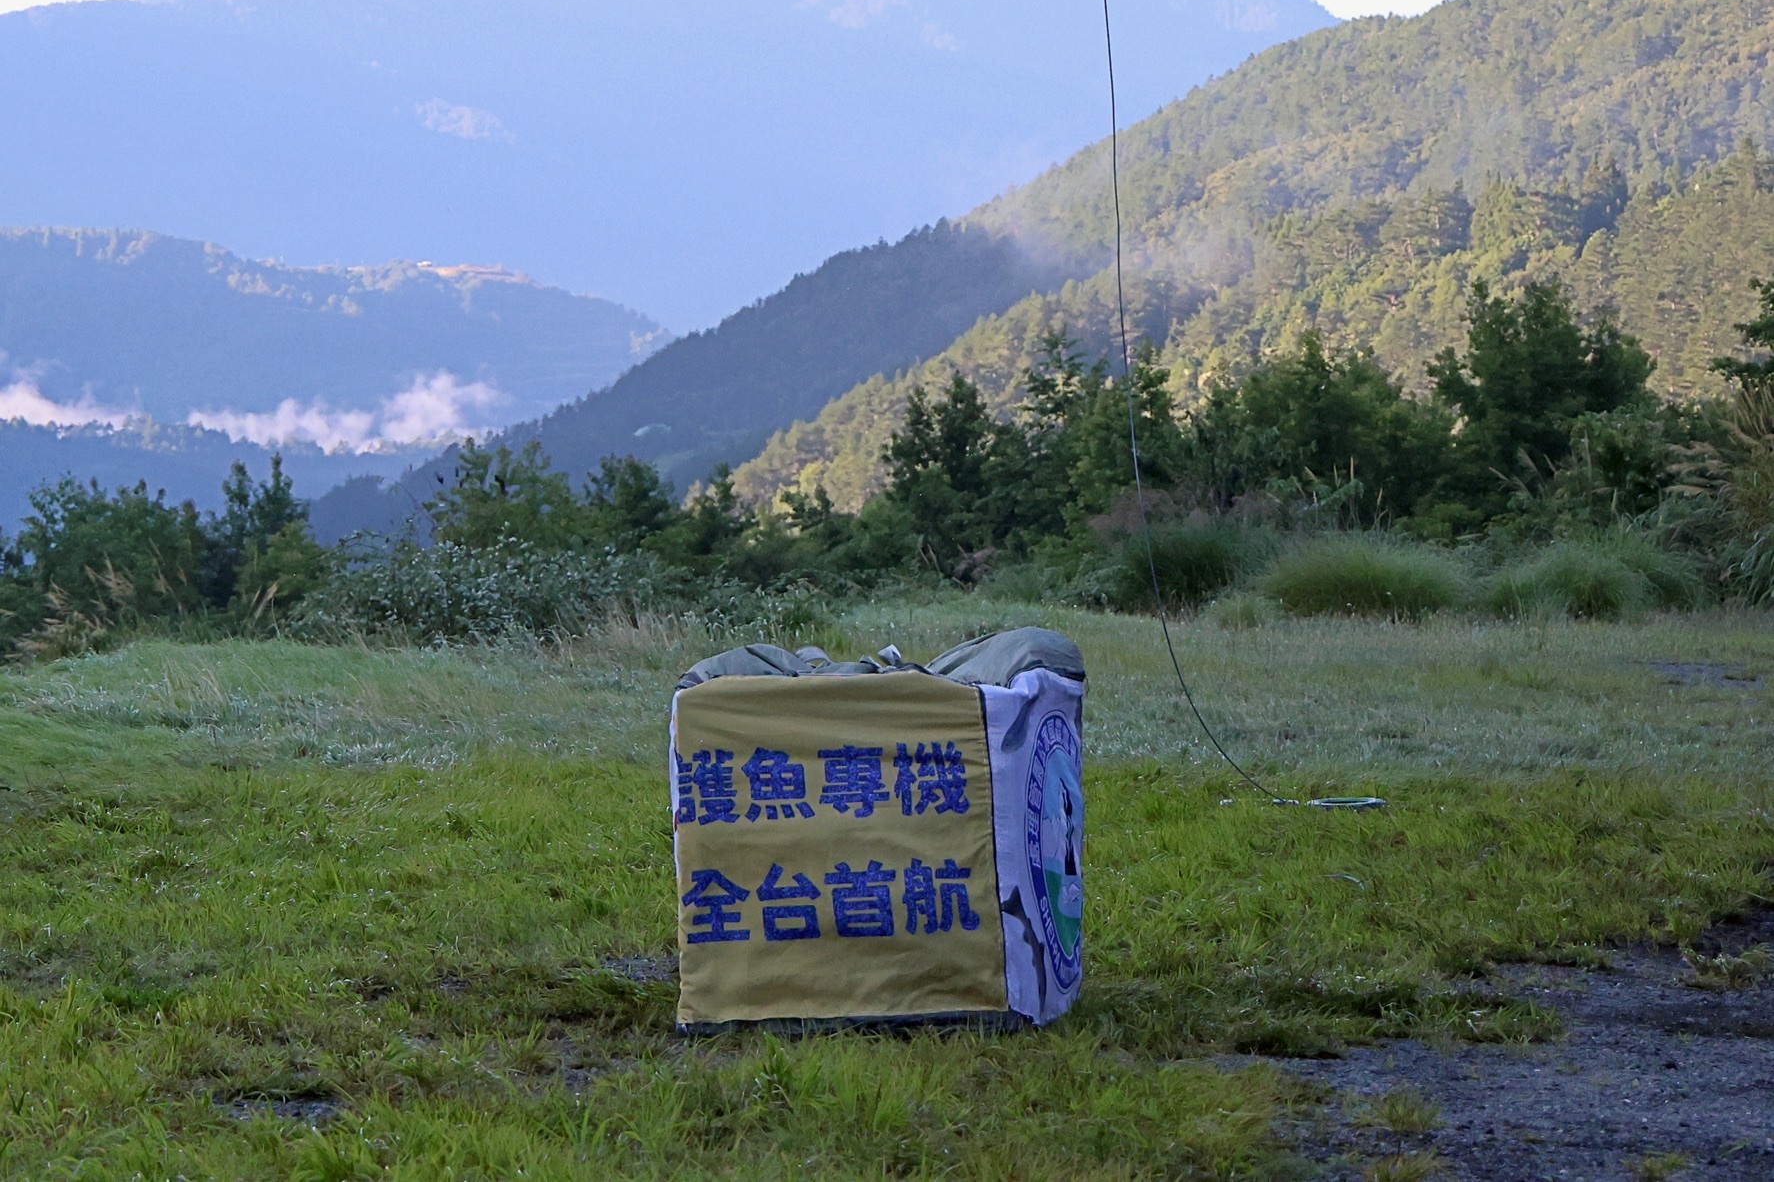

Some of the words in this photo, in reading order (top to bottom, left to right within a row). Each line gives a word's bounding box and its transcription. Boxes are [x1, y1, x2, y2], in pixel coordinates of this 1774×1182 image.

[676, 741, 970, 825] 護魚專機
[681, 858, 980, 944] 全台首航
